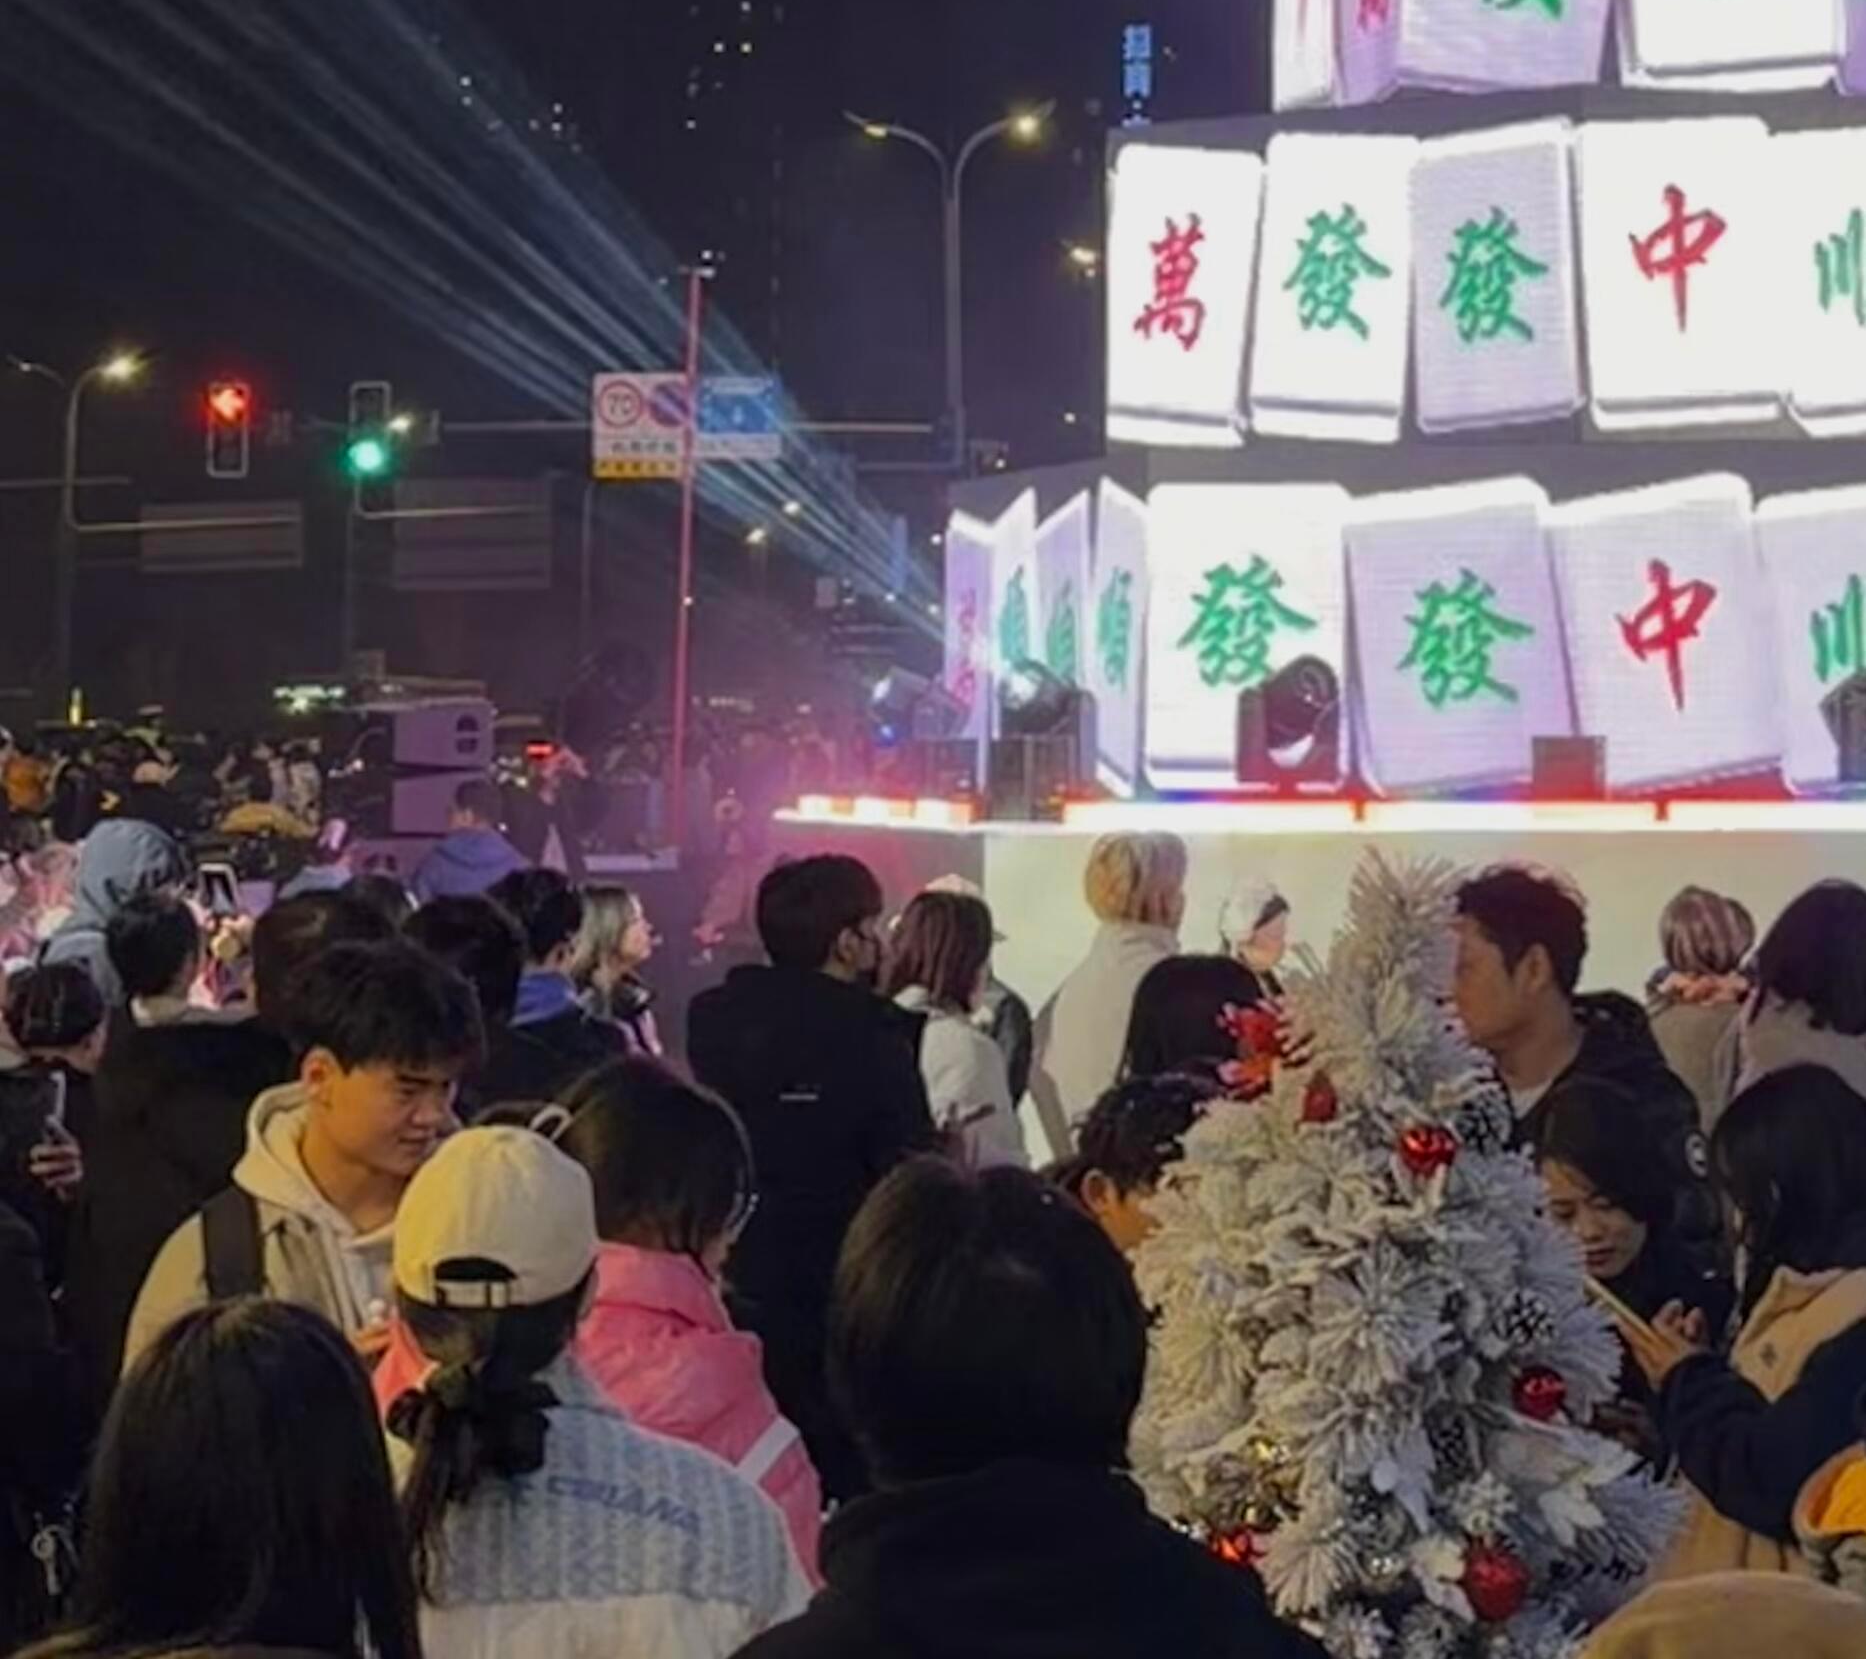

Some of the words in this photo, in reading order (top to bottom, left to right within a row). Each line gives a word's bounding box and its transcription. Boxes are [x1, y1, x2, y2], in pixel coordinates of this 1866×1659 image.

[1132, 212, 1207, 353] 萬
[1282, 201, 1393, 342] 發
[1439, 204, 1551, 347] 發
[1630, 184, 1727, 332] 中
[1176, 551, 1318, 687] 發
[1398, 567, 1536, 711] 發
[1615, 559, 1718, 713] 中
